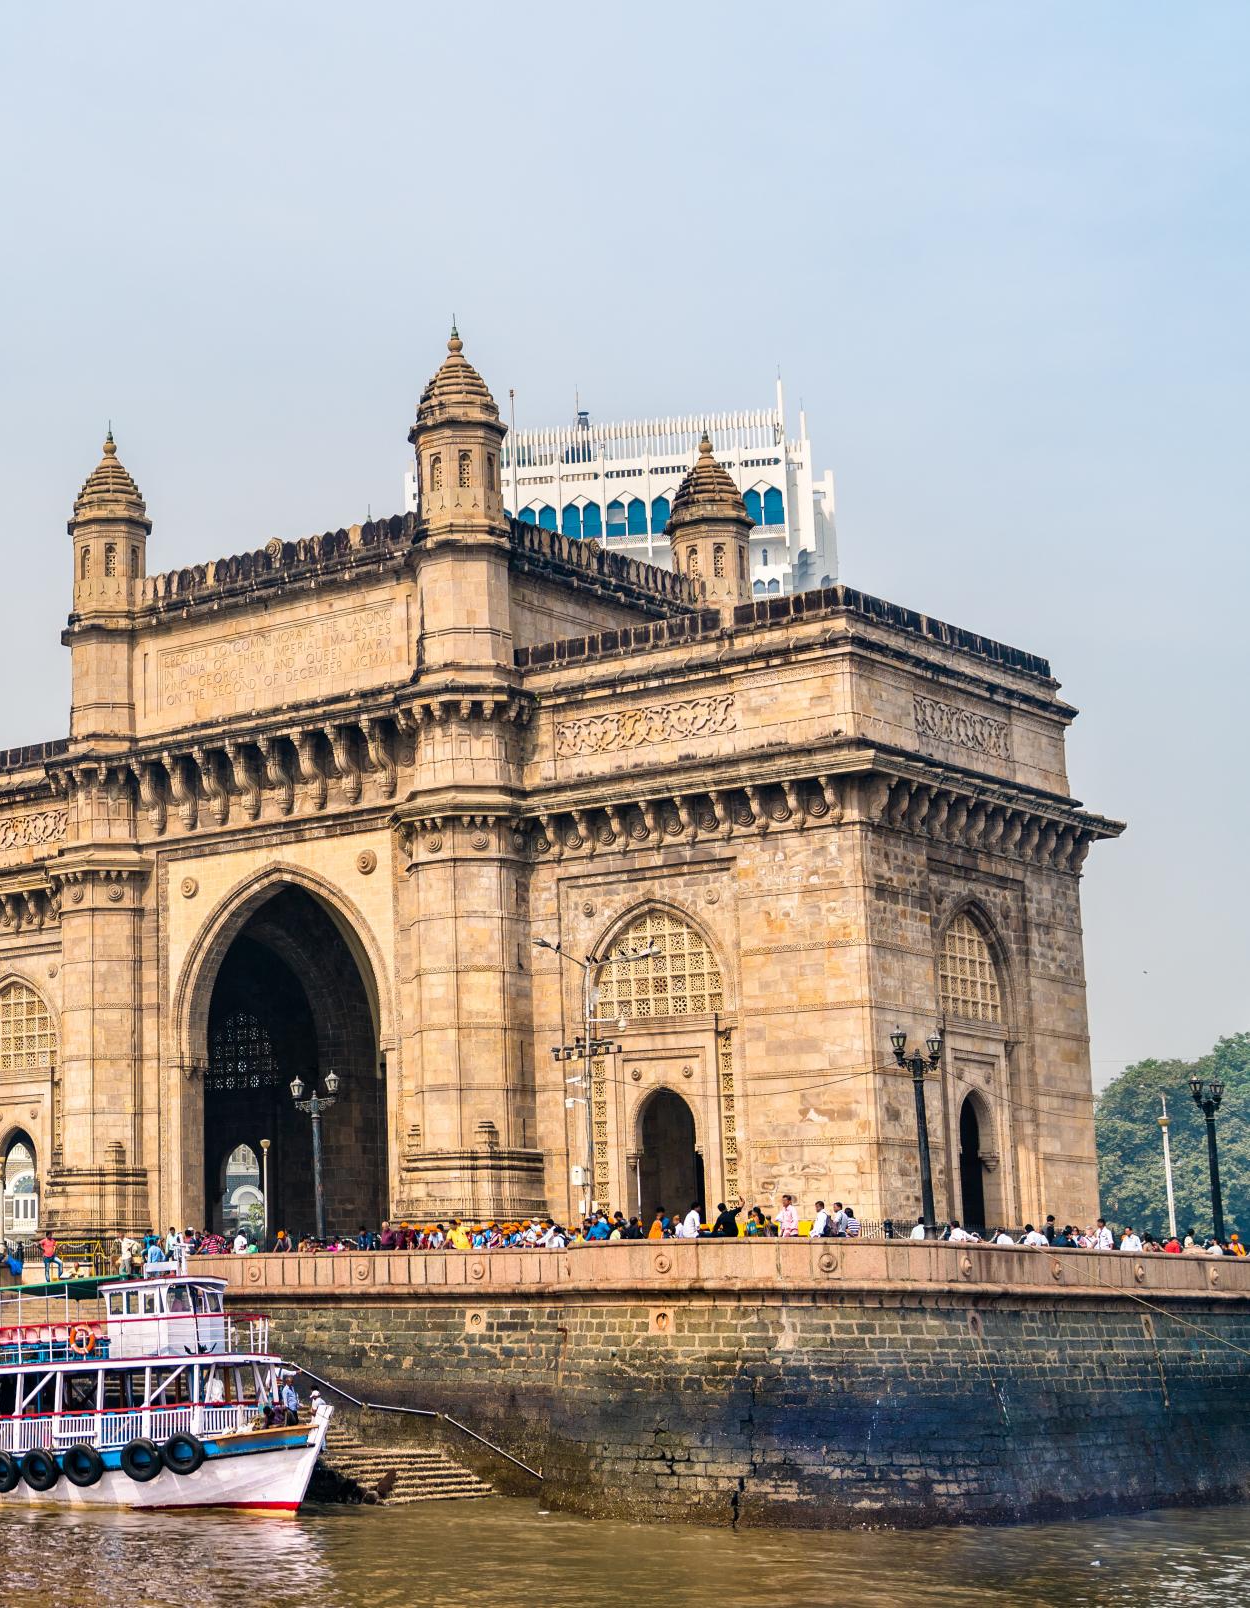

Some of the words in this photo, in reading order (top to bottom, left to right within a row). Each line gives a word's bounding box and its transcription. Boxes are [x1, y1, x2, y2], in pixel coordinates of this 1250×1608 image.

[164, 650, 206, 668] ERECTED
[213, 645, 227, 657] TO
[233, 626, 315, 652] COMMEMORATE
[319, 620, 338, 634] THE
[345, 609, 391, 629] LANDING
[164, 670, 173, 680] IN
[180, 664, 205, 677] INDIA
[214, 658, 228, 670] OF
[237, 651, 264, 665] THEIR
[273, 638, 321, 657] IMPERIAL
[330, 623, 391, 646] MAJESTIES
[164, 680, 187, 693] KING
[198, 667, 244, 686] GEORGE
[274, 657, 295, 670] AND
[306, 647, 347, 664] QUEEN
[356, 638, 391, 654] MARY
[166, 694, 181, 705] ON
[187, 689, 204, 701] THE
[213, 679, 256, 697] SECOND
[264, 674, 278, 686] OF
[286, 660, 342, 682] DECEMBER
[350, 651, 391, 669] MCMXI
